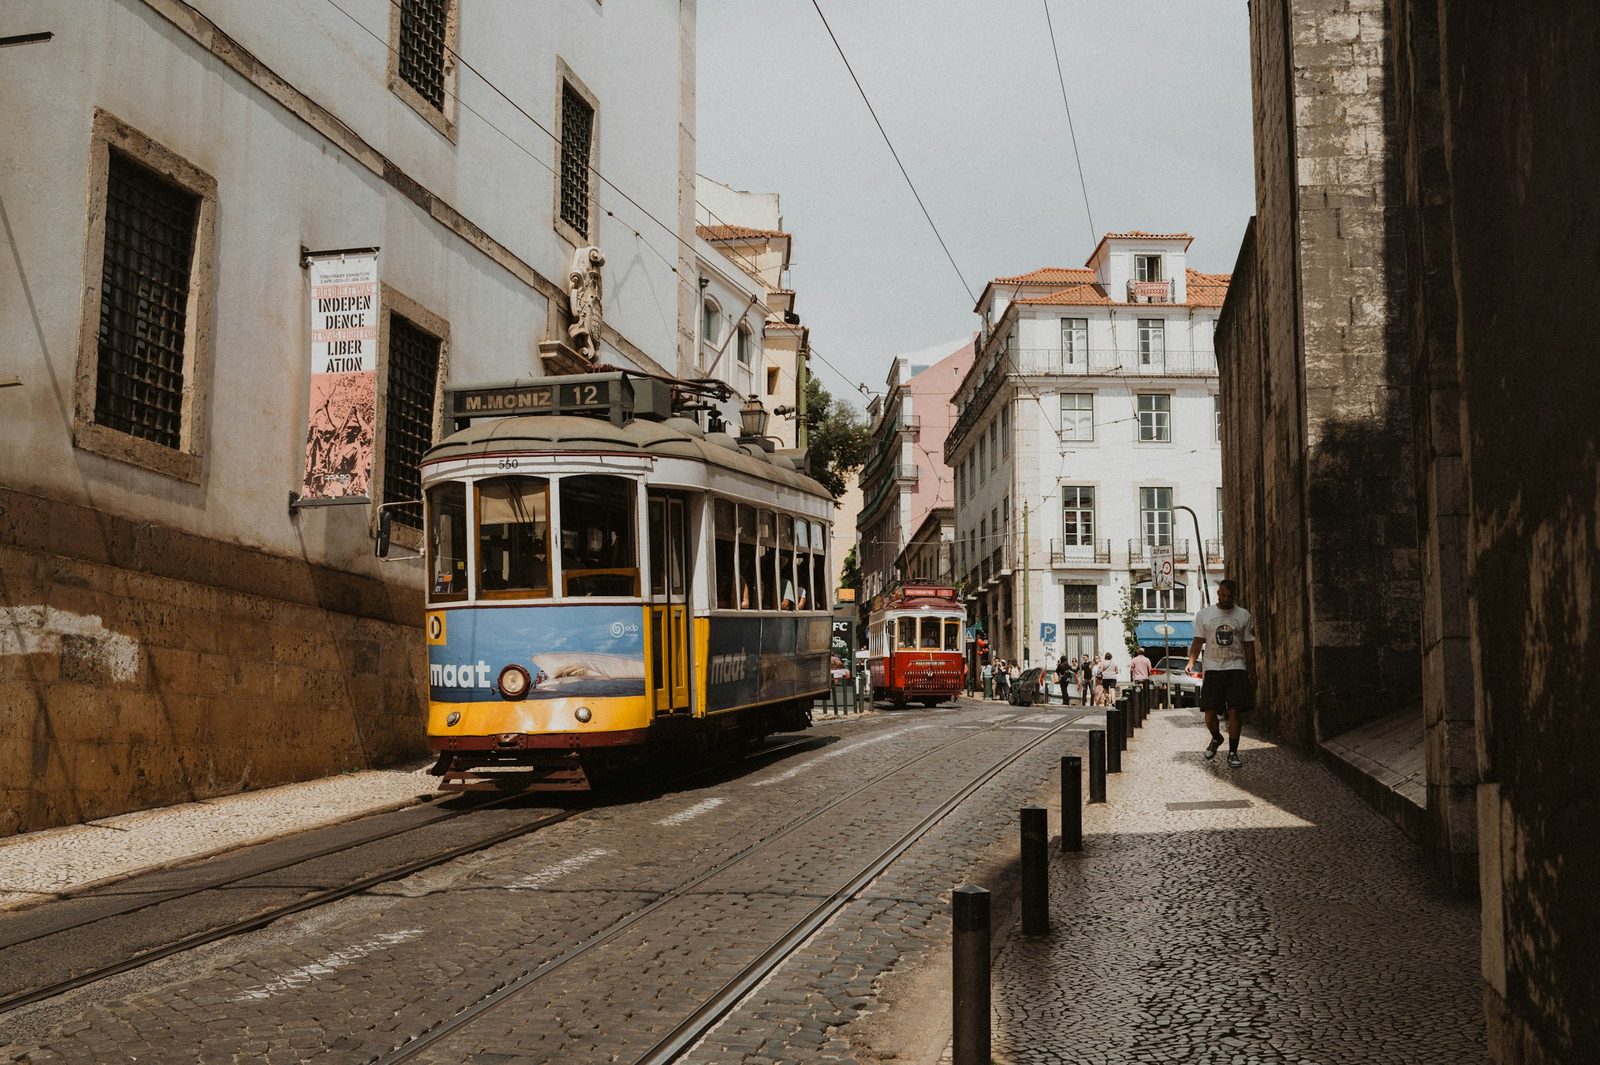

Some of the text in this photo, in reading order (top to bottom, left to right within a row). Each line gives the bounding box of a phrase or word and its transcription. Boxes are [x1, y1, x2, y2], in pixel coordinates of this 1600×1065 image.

[316, 284, 373, 298] BEFORE IT WAS
[318, 295, 371, 313] INDEPEN
[325, 313, 365, 330] DENCE
[327, 339, 362, 356] LIBER
[325, 356, 363, 373] ATION
[465, 391, 552, 411] M.MONIZ
[572, 385, 598, 405] 12
[498, 459, 519, 470] 550
[833, 621, 848, 632] FC
[429, 660, 491, 688] maat
[710, 646, 747, 685] maat
